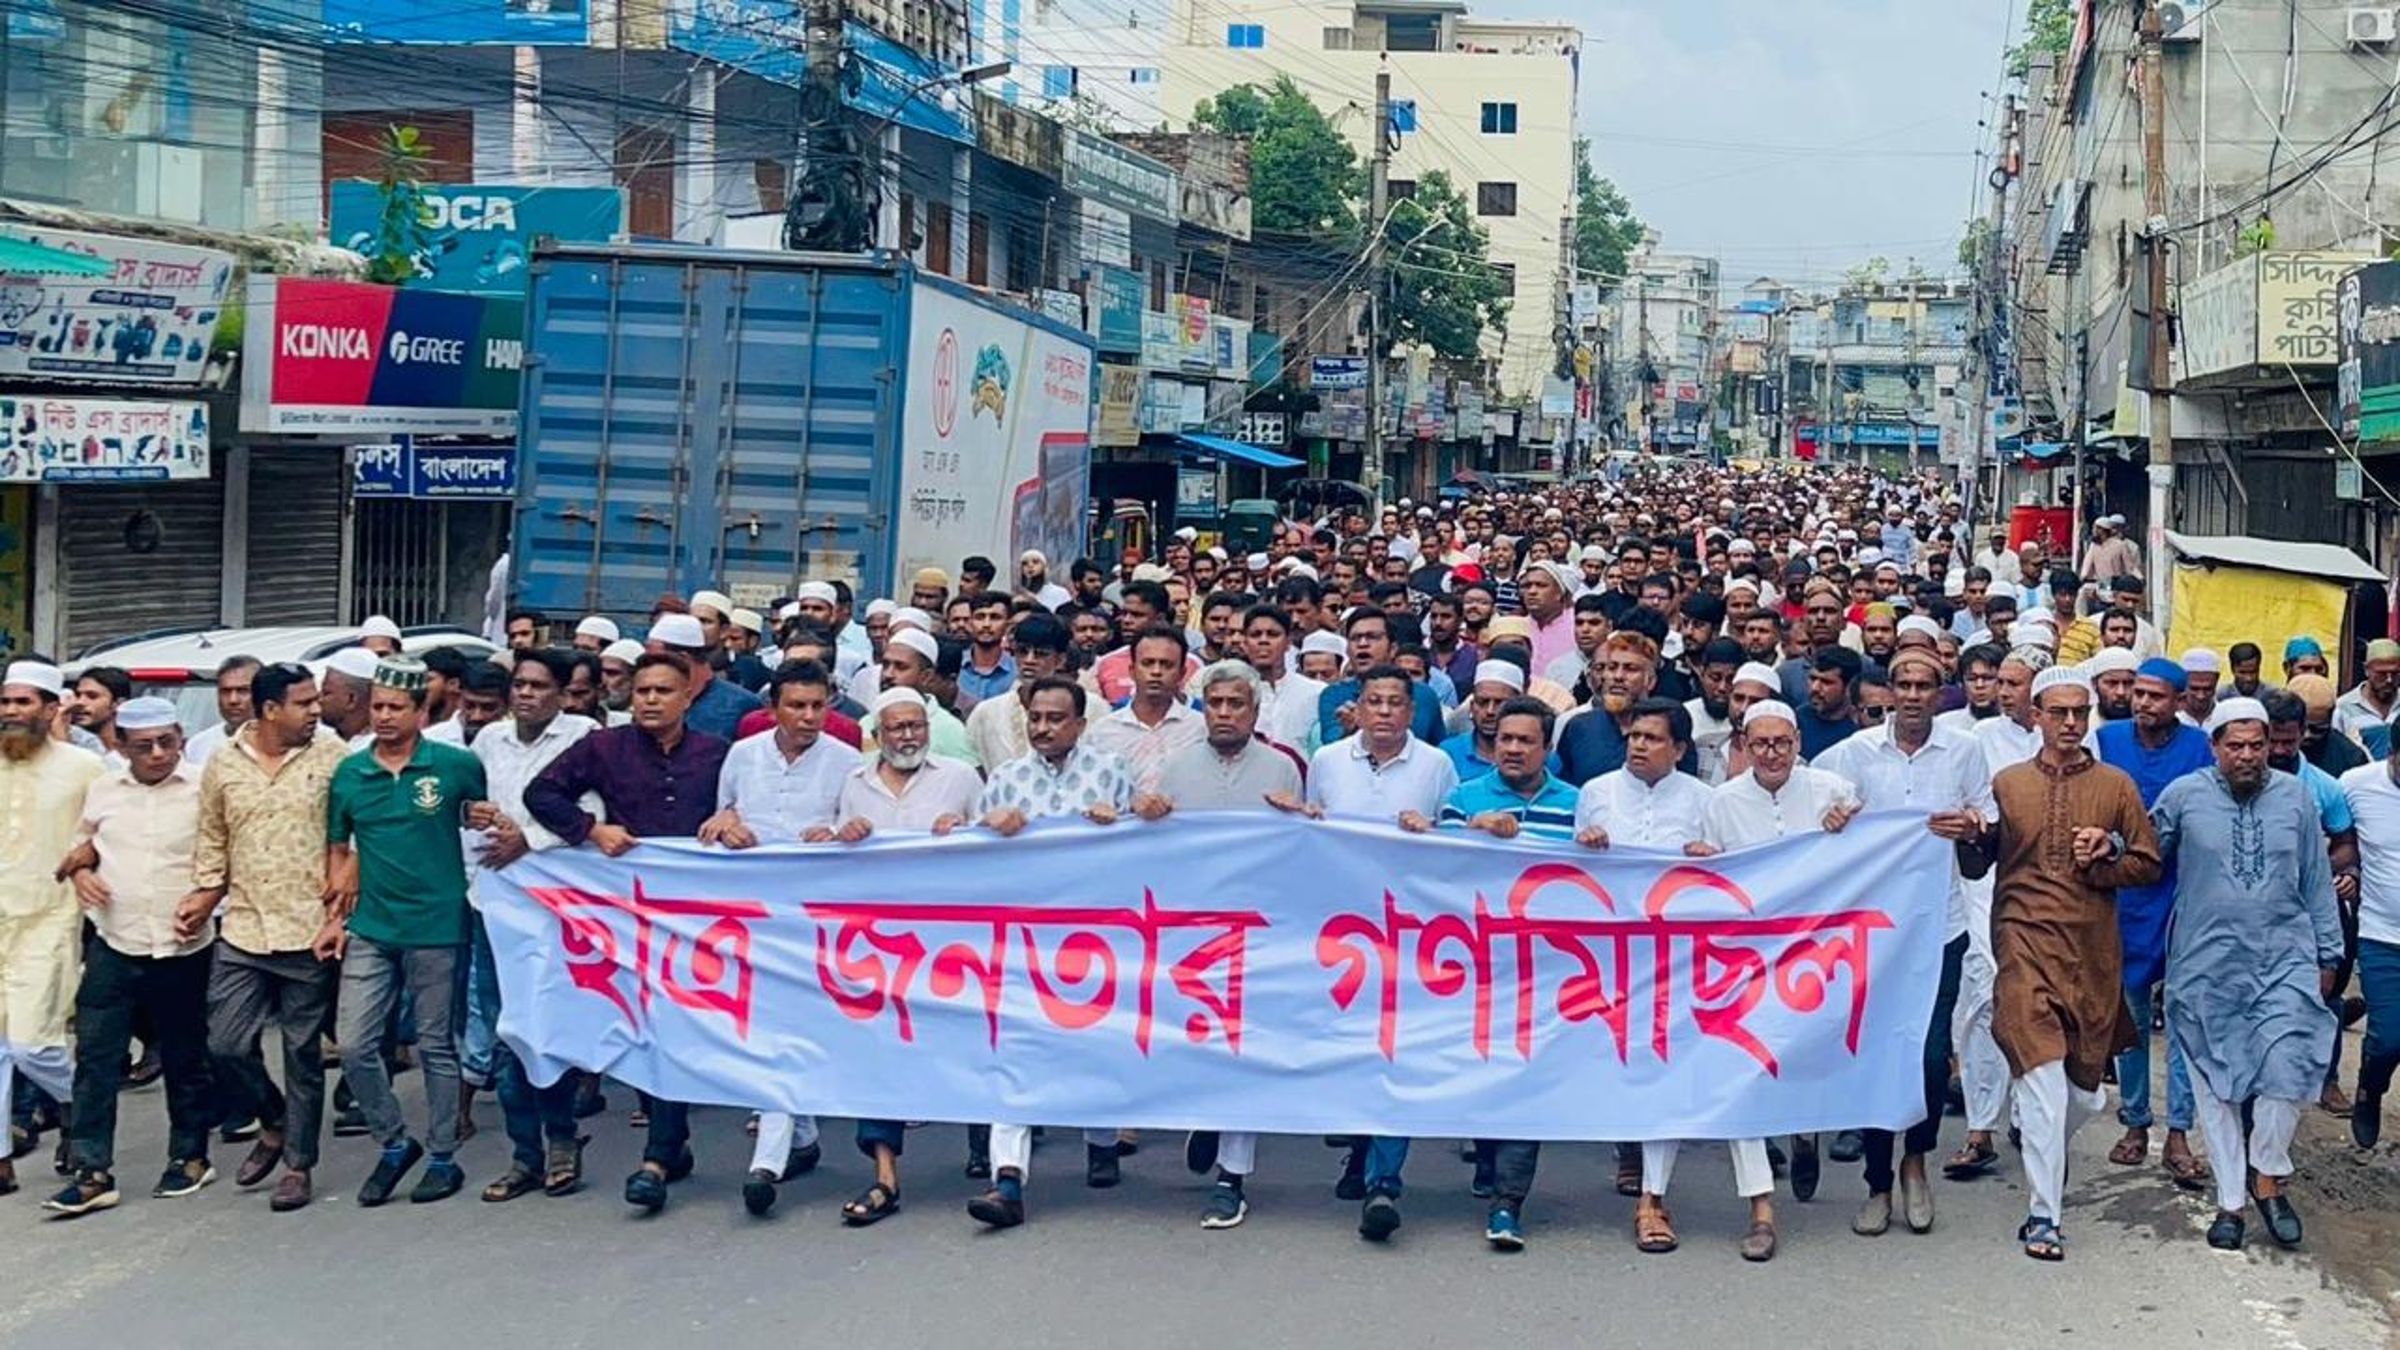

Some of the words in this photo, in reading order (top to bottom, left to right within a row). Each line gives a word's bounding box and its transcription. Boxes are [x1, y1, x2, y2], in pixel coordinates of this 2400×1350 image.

[281, 323, 371, 361] KONKA
[410, 336, 465, 365] GREE
[419, 456, 507, 481] বাংলাদেশ
[525, 874, 771, 1042] ছাত্র
[803, 885, 1270, 1060] জনতার
[1315, 862, 1896, 1080] গণমিছিল
